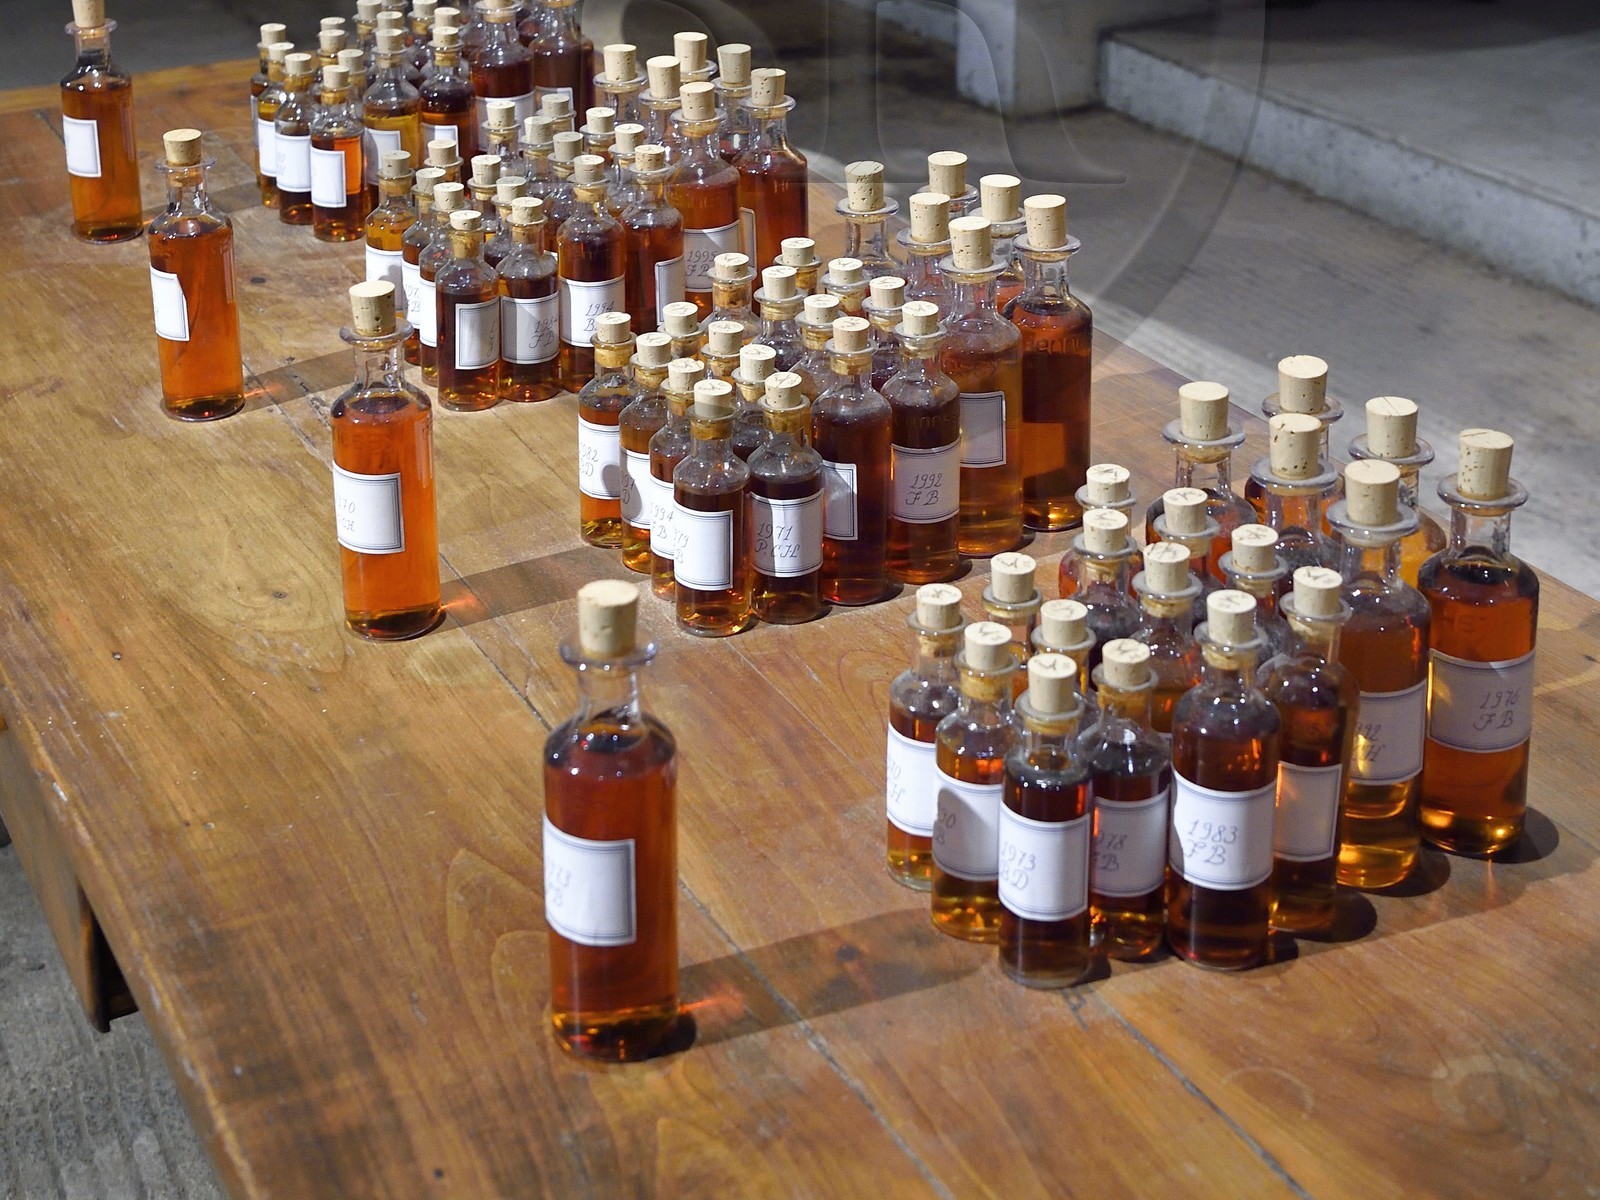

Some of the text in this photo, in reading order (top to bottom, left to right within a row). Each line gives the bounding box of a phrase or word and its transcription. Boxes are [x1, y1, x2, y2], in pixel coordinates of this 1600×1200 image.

[910, 472, 942, 489] 1992
[757, 522, 793, 541] 1971
[1480, 689, 1520, 709] 1976
[1188, 819, 1238, 845] 1983
[1001, 841, 1036, 871] 1973
